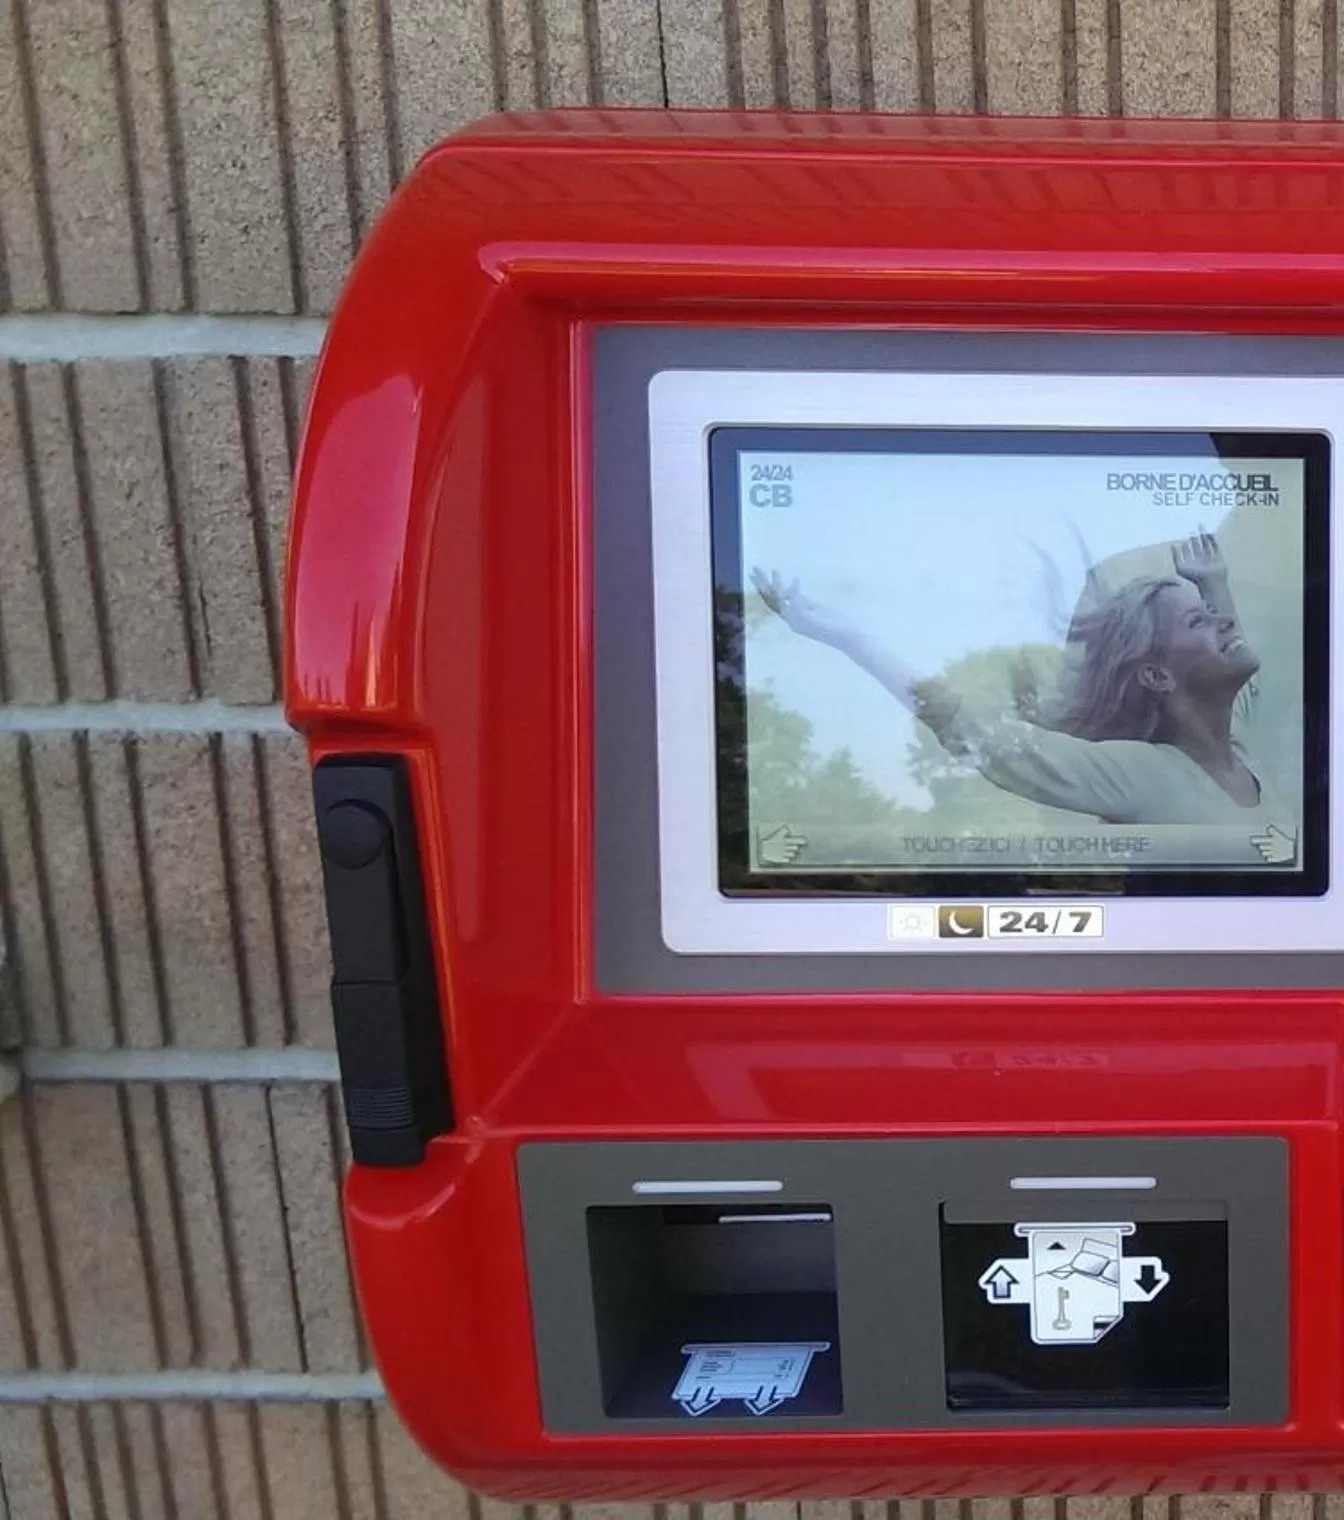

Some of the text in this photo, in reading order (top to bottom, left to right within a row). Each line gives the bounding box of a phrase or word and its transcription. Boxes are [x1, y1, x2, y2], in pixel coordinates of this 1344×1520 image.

[750, 463, 793, 481] 24/24
[1106, 472, 1177, 491] BORNE
[749, 483, 793, 508] CB
[1153, 491, 1280, 507] SELF CHECK-IN
[1000, 908, 1092, 934] 24/7
